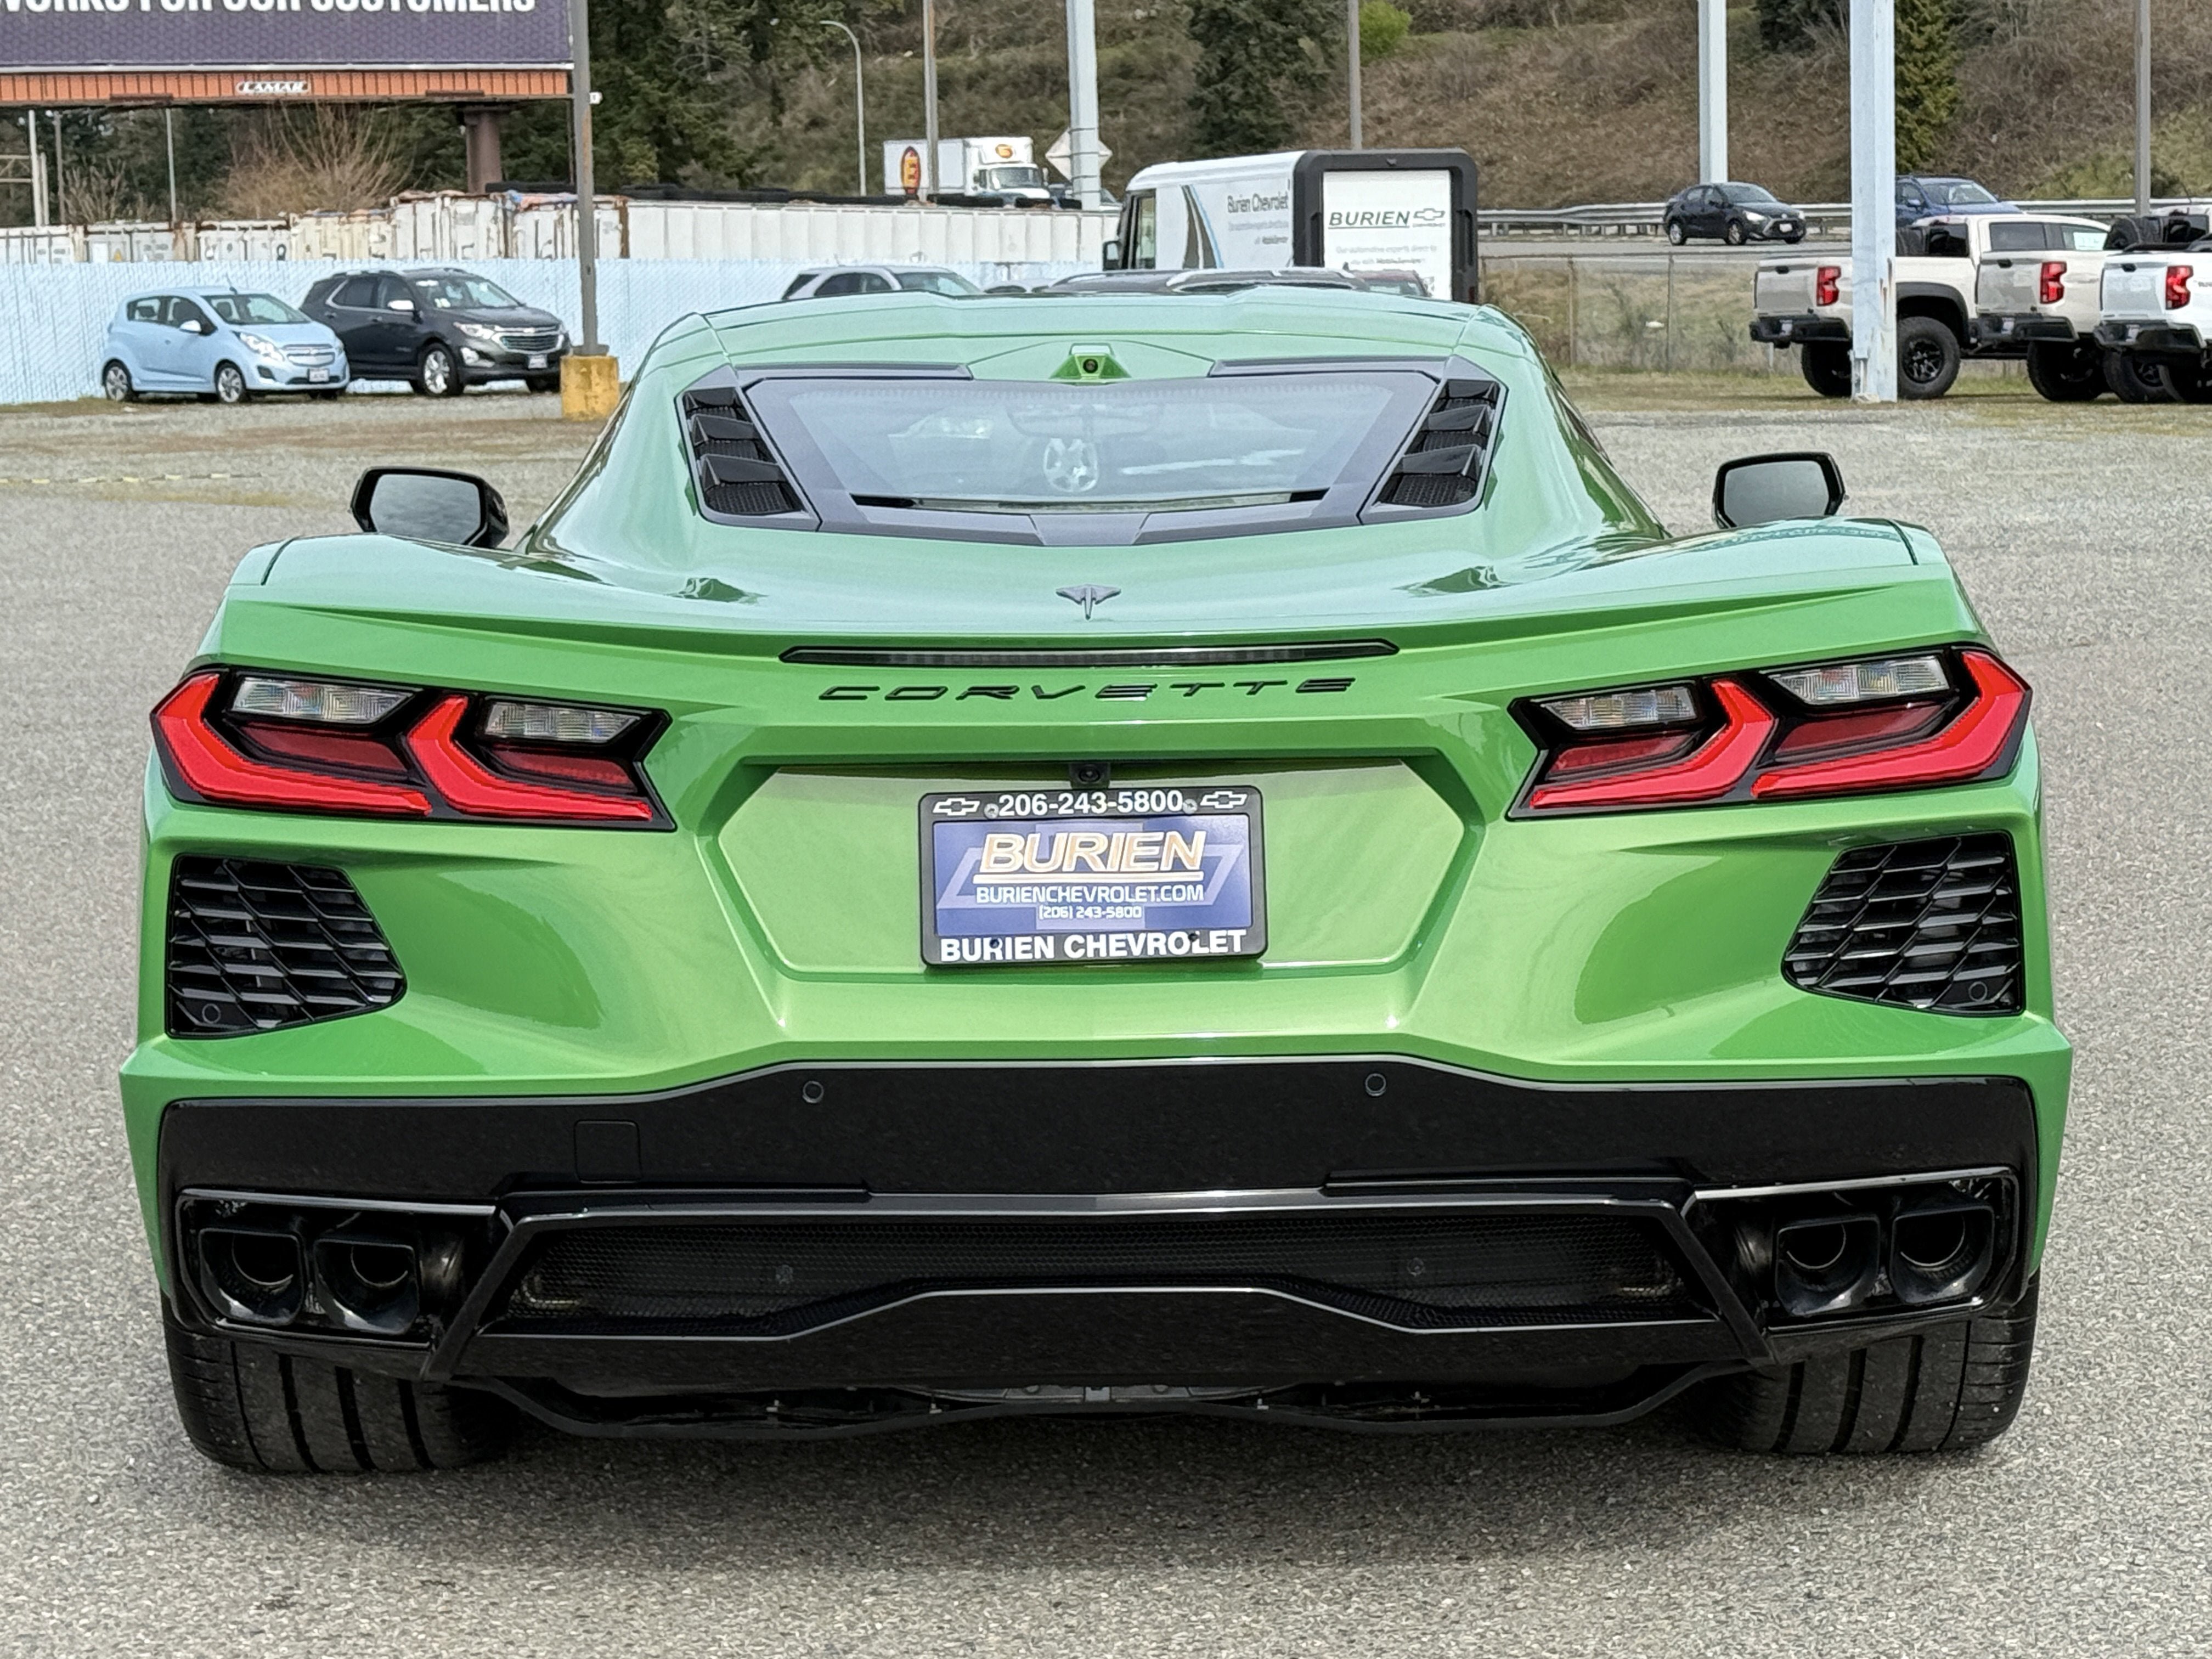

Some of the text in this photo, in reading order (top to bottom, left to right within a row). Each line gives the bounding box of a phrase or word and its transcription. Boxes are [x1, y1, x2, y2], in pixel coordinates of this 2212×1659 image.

[1329, 211, 1410, 226] BURIEN
[818, 677, 1357, 701] CORVETTE
[998, 790, 1183, 816] 206-243-5800
[979, 831, 1206, 873] BURIEN
[976, 884, 1204, 904] BURIENCHEVROLET.COM
[1076, 905, 1142, 919] 243-5800
[940, 929, 1246, 962] BURIEN CHEVROLET
